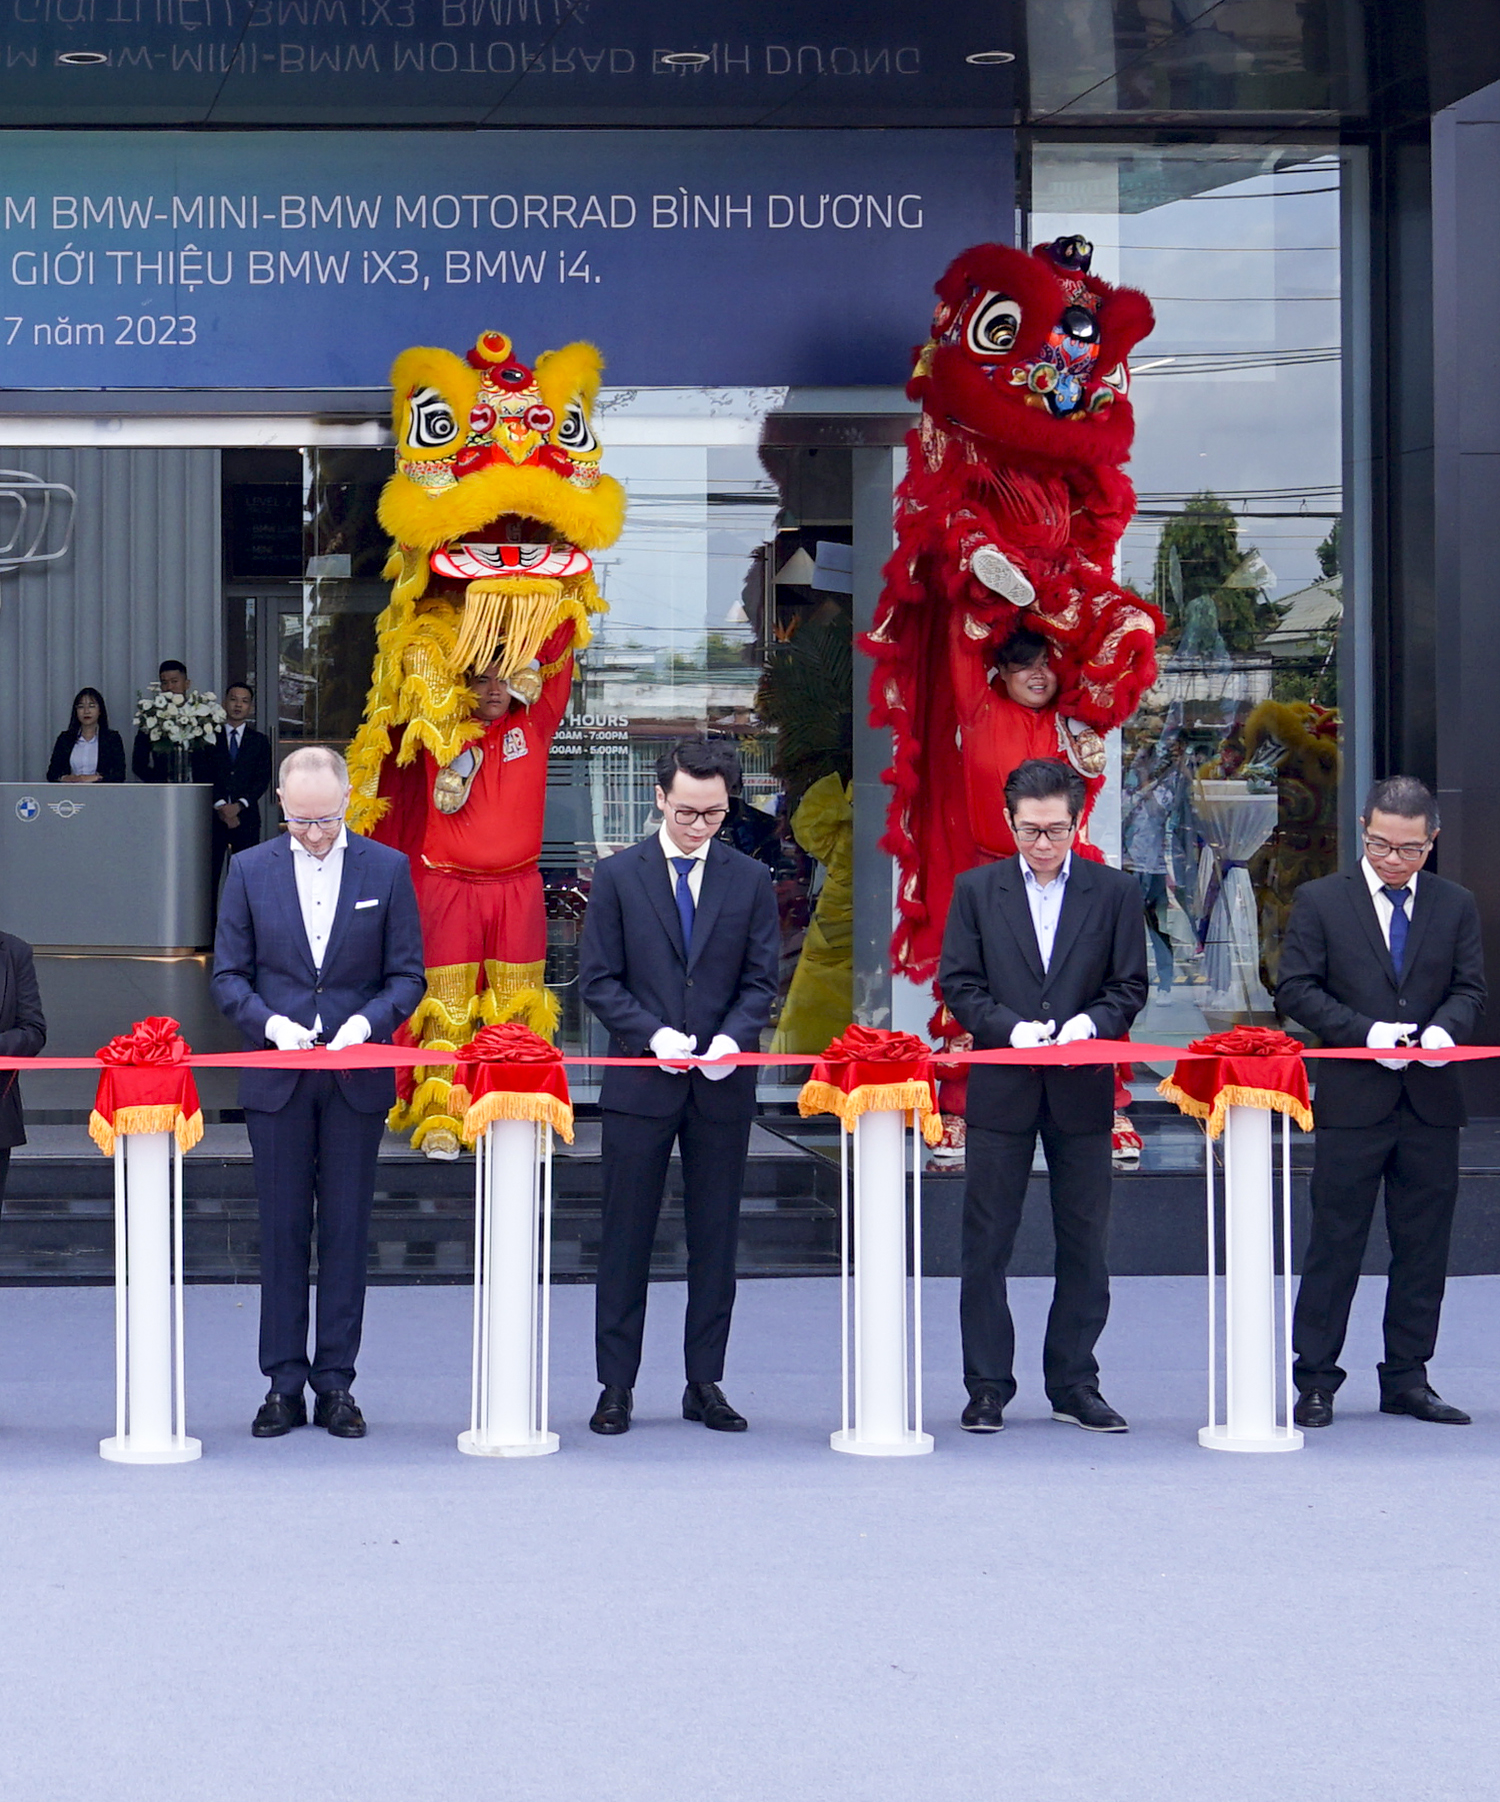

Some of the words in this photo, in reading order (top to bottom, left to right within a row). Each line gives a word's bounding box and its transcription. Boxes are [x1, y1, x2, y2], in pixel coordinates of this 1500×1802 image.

[52, 194, 382, 230] BMW-MINI-BMW
[395, 194, 637, 229] MOTORRAD
[652, 186, 752, 229] BÌNH
[768, 192, 923, 229] DƯƠNG
[11, 242, 94, 286] GIỚI
[105, 243, 233, 293] THIỆU
[249, 250, 351, 285] BMW
[363, 249, 430, 291] iX3,
[445, 250, 547, 284] BMW
[559, 250, 601, 284] i4.
[3, 316, 24, 346] 7
[33, 316, 104, 346] năm
[114, 315, 197, 346] 2023
[569, 714, 629, 727] HOURS
